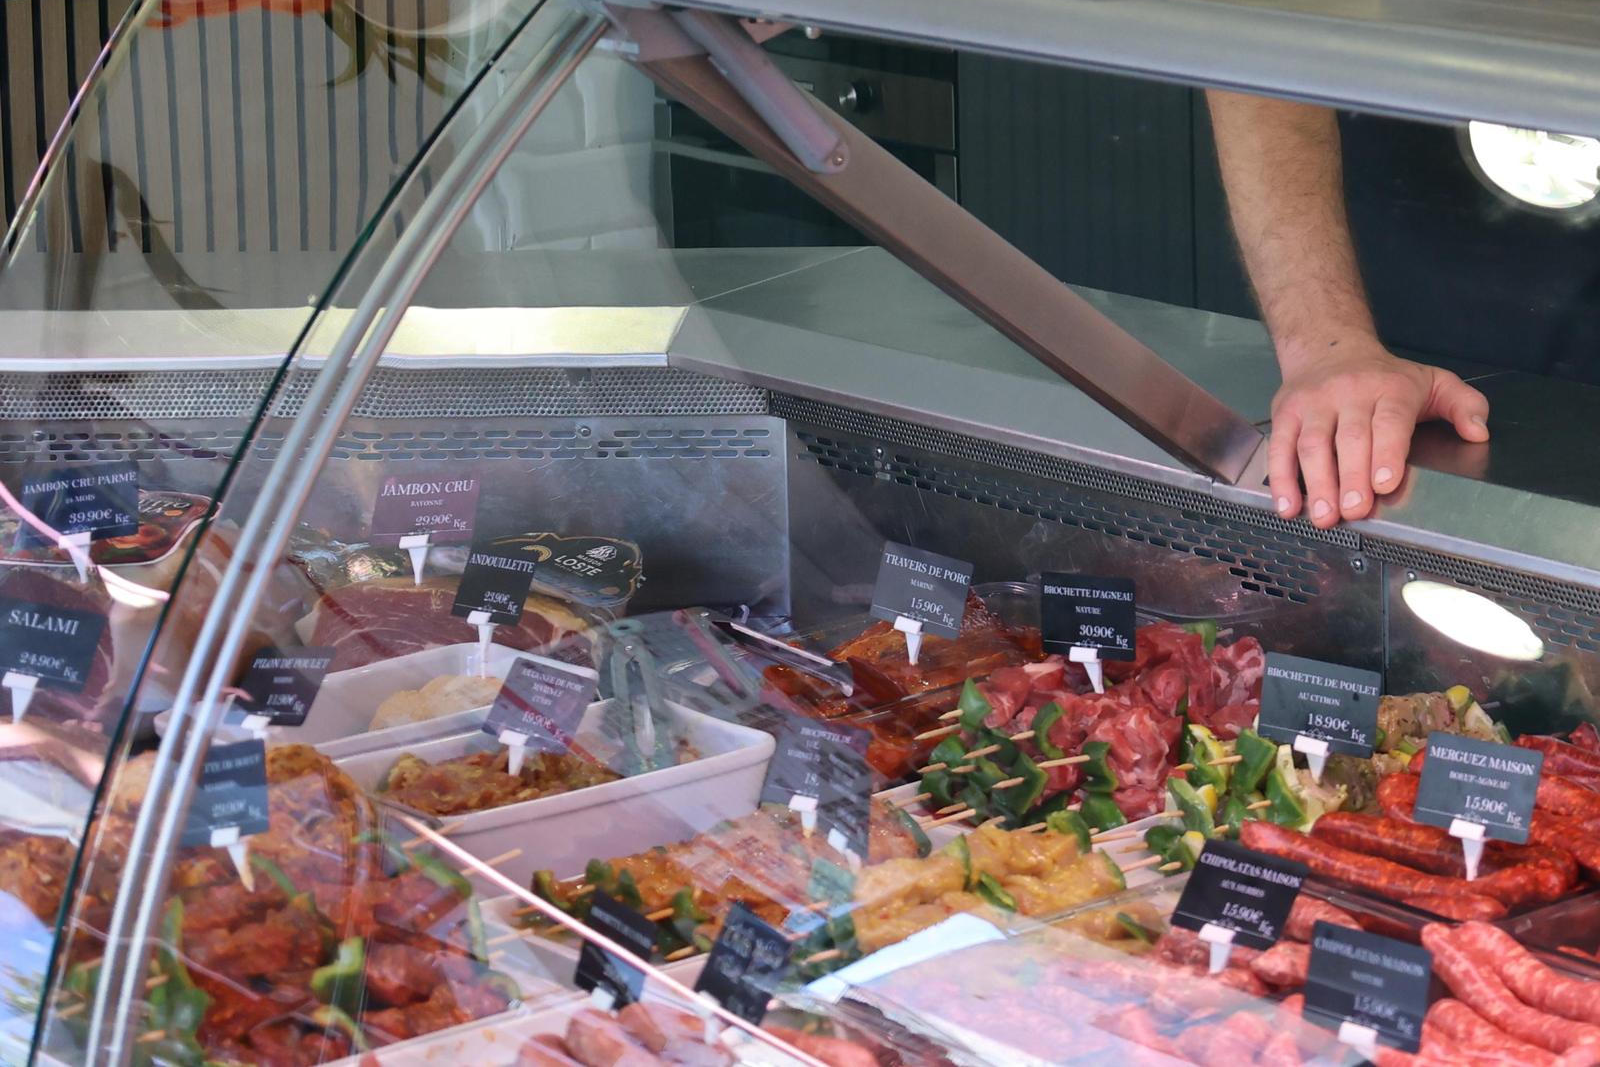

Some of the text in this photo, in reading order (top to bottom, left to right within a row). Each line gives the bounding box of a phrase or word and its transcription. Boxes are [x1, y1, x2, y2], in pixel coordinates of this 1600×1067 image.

[24, 471, 137, 495] JAMBON CRU PARME
[381, 479, 476, 497] JAMBON CRU
[114, 513, 131, 526] Kg
[453, 518, 467, 530] Kg
[469, 553, 536, 573] ANDOUILLETTE
[554, 555, 603, 576] LOSTE
[885, 552, 971, 586] TRAVERS DE PORC
[1043, 585, 1134, 603] BROCHETTE D'AGNEAU
[507, 601, 518, 614] Kg
[1075, 605, 1102, 616] NATURE
[8, 609, 80, 635] SALAMI
[942, 612, 955, 628] Kg
[1115, 634, 1129, 649] Kg
[63, 666, 79, 681] Kg
[1266, 666, 1379, 696] BROCHETTE DE POULET
[1298, 692, 1341, 706] AU CITRON
[1350, 728, 1367, 744] Kg
[1430, 745, 1536, 776] MERGUEZ MAISON
[1506, 811, 1522, 829] Kg
[1200, 852, 1302, 888] CHIPOLATAS MAISON
[1258, 919, 1275, 937] Kg
